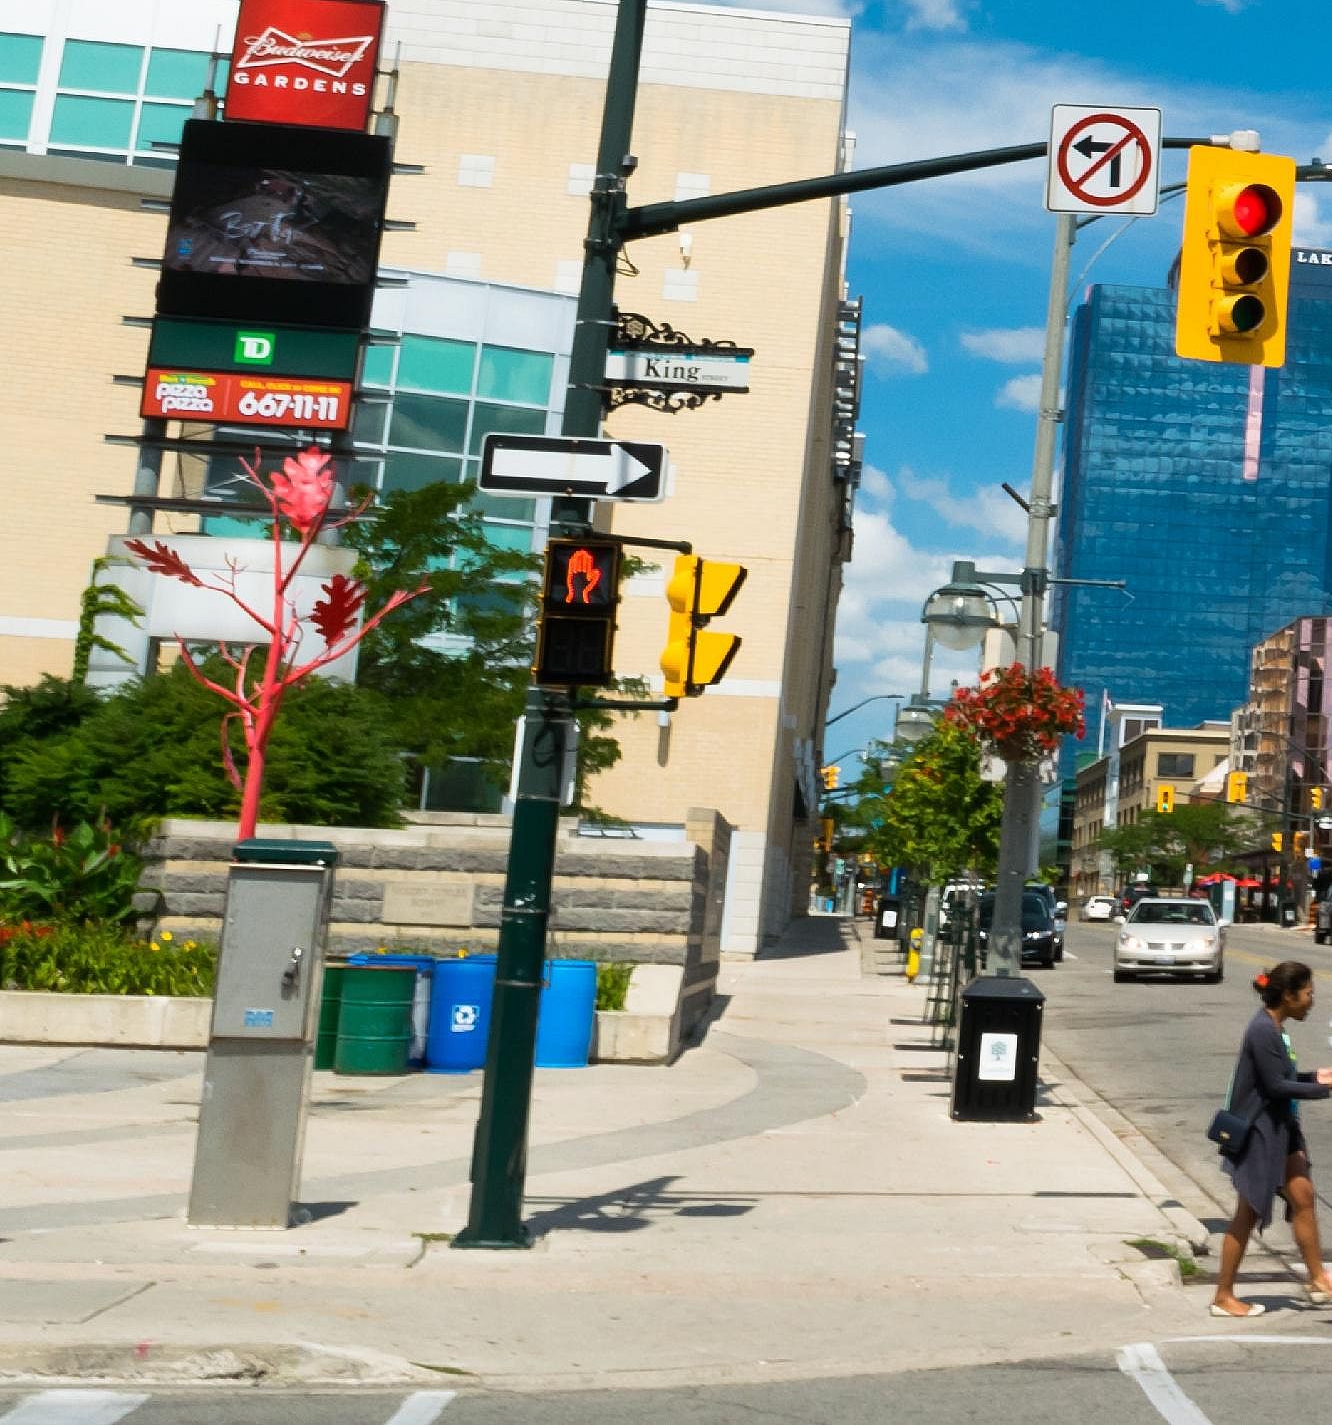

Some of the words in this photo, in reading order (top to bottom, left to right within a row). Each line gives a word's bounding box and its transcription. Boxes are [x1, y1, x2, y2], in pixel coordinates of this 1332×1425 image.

[243, 36, 364, 63] Budweiser
[233, 71, 366, 96] GARDENS
[240, 336, 271, 359] TD
[644, 357, 701, 383] King
